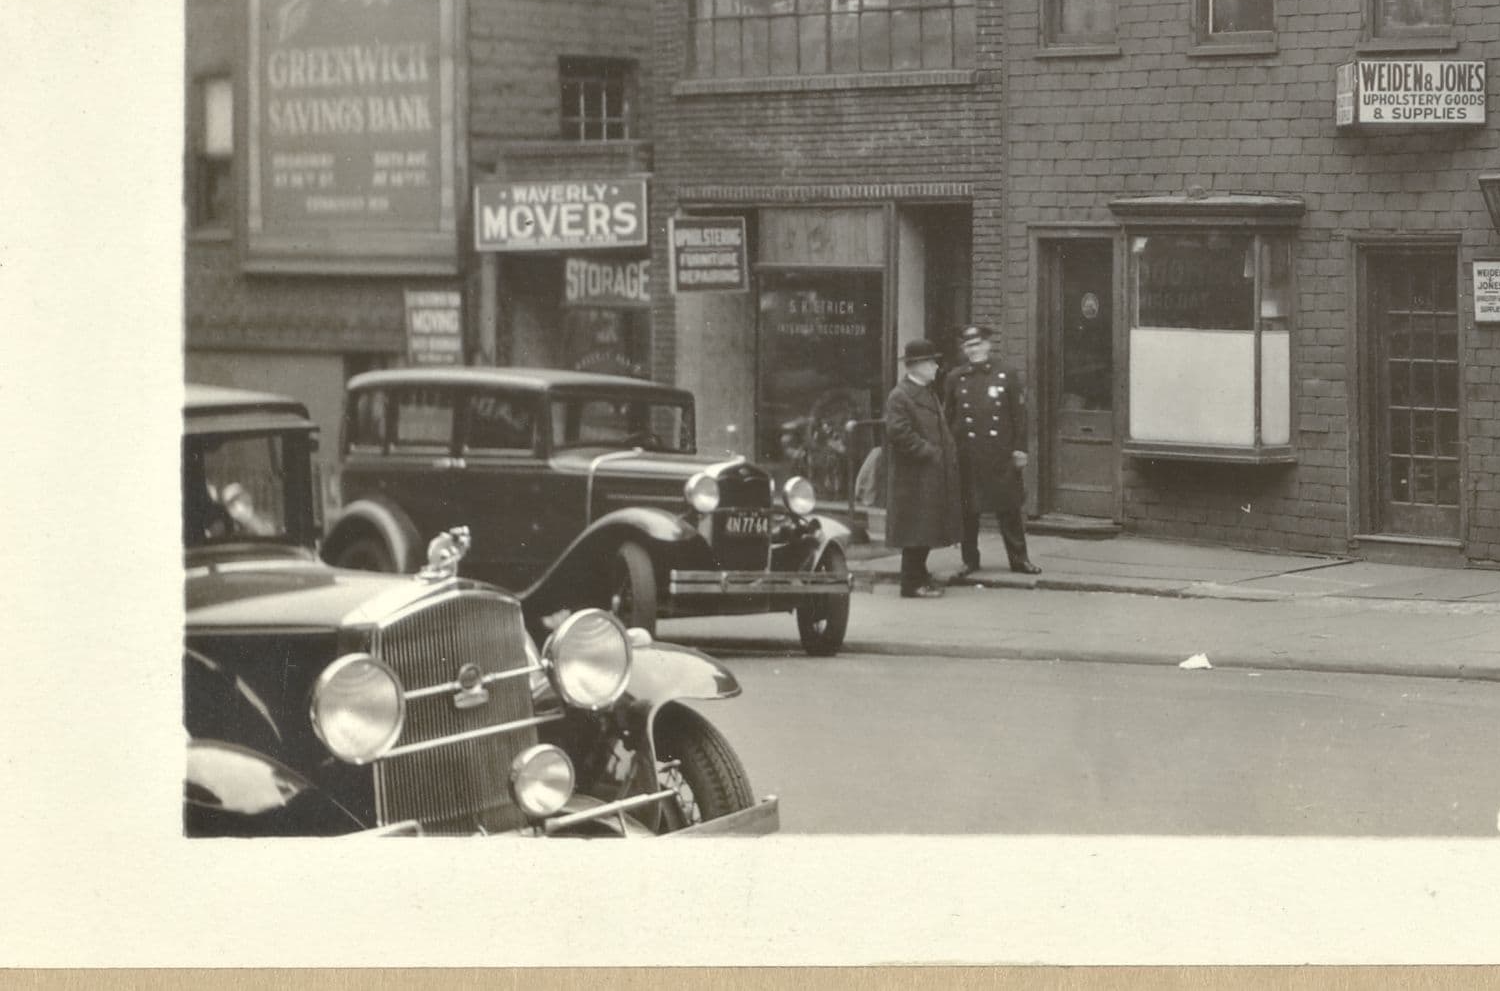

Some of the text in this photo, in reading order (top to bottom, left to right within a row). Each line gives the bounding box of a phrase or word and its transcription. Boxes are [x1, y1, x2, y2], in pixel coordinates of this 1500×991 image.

[1361, 63, 1485, 92] WEIDEN & JONES
[1363, 94, 1484, 106] UPHOLSTERY GOODS
[1374, 107, 1467, 119] & SUPPLIES
[269, 97, 364, 134] SAVINGS
[513, 184, 607, 203] WAVERLY
[483, 202, 638, 241] MOVERS
[565, 258, 650, 301] STORAGE
